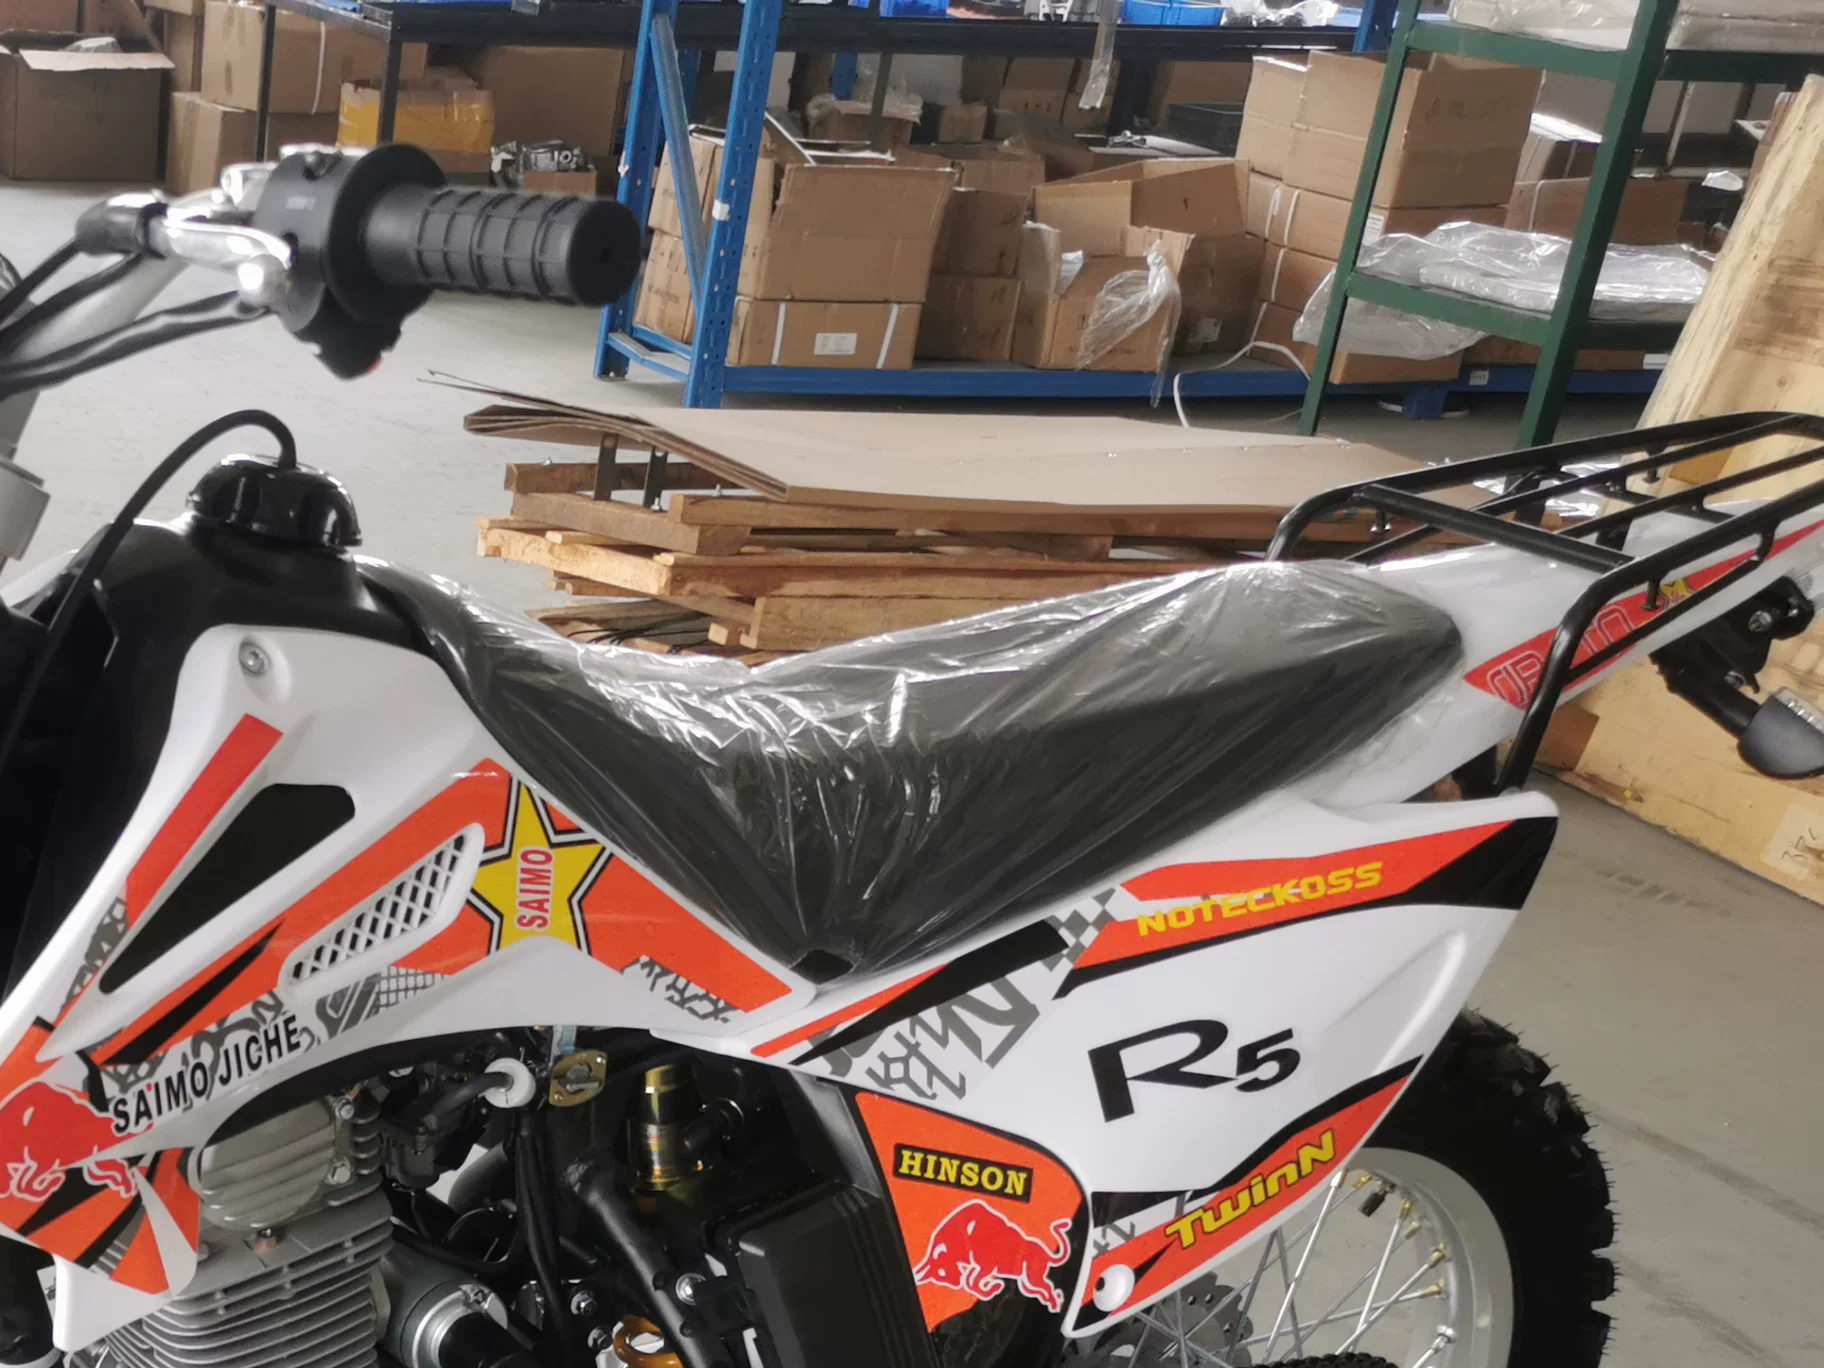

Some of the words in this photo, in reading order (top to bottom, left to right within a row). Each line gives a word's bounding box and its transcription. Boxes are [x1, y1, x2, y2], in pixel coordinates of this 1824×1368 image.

[516, 848, 554, 930] SAIMO
[1137, 861, 1382, 936] NOTECKOSS
[112, 1060, 209, 1134] SAIMO
[218, 1013, 301, 1087] JICHE
[1087, 1019, 1301, 1123] R5
[898, 1149, 1028, 1196] HINSON
